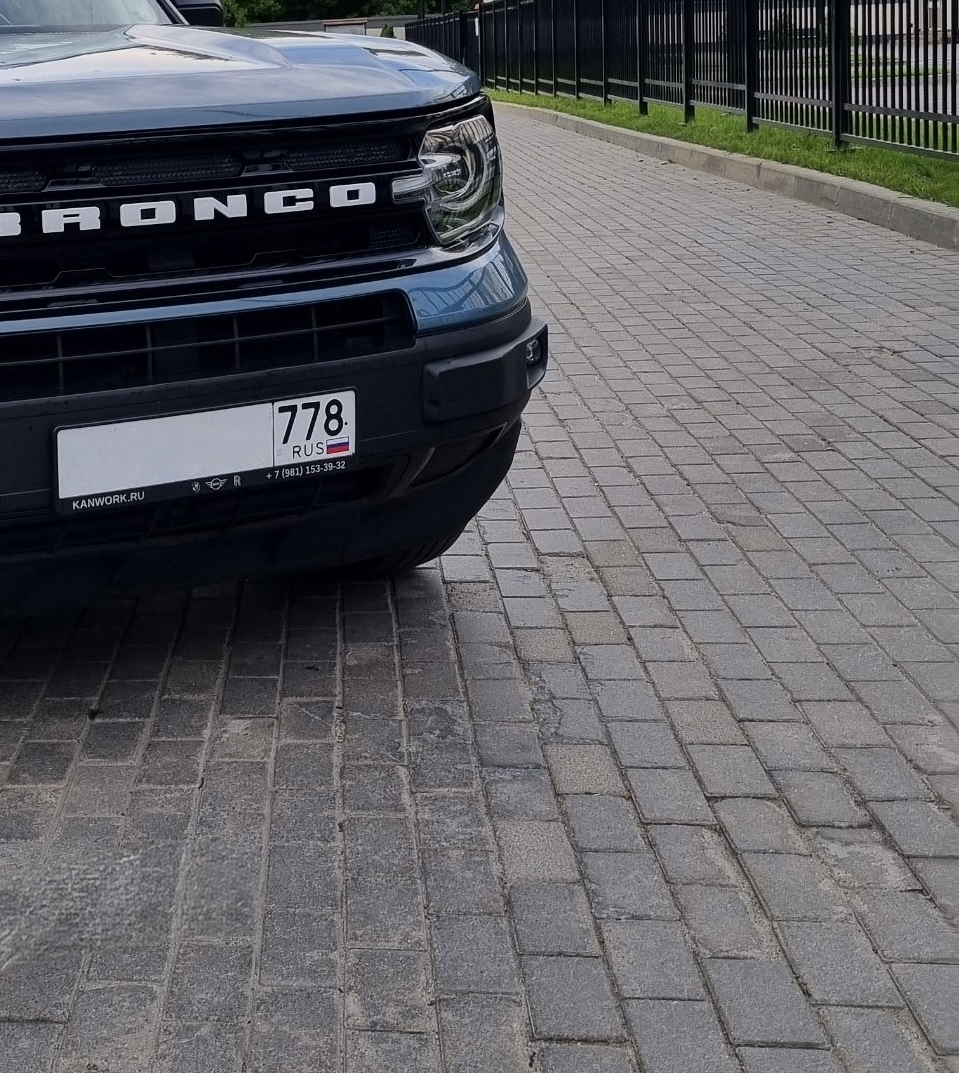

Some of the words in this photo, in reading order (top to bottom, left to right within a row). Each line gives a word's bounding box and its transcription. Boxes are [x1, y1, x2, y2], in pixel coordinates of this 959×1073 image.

[278, 399, 344, 444] 778
[292, 442, 324, 459] RUS
[282, 466, 303, 479] (981)
[305, 461, 346, 475] 153-39-32
[72, 491, 145, 510] KANWORK.RU
